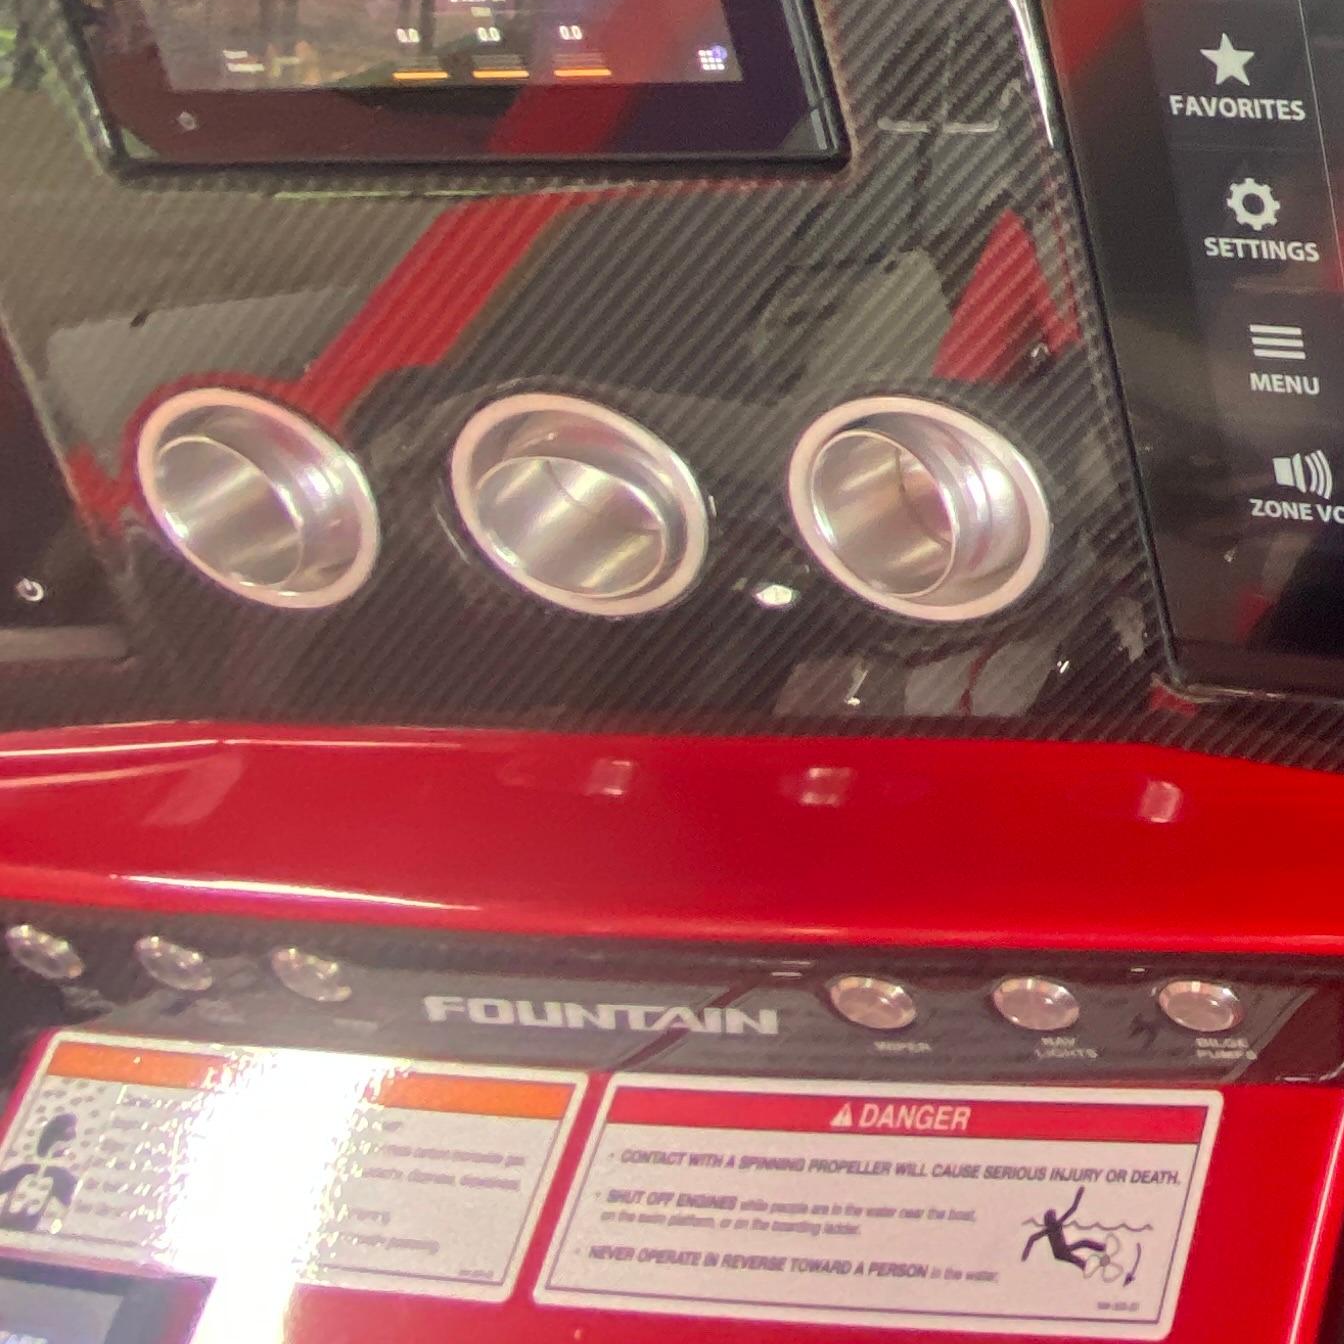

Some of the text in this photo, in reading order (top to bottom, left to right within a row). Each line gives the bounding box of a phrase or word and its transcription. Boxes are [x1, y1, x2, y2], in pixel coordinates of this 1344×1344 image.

[1169, 95, 1306, 121] FAVORITES
[1204, 237, 1320, 262] SETTINGS
[1250, 372, 1320, 395] MENU
[1250, 499, 1313, 521] ZONE
[422, 996, 778, 1035] FOUNTAIN
[859, 1104, 971, 1131] DANGER
[621, 1149, 1181, 1185] CONTACT WITH A SPINNING PROPELLER WILL CAUSE SERIOUS INJURY OR DEATH.
[646, 1191, 675, 1206] OFF
[588, 1245, 635, 1261] NEVER
[637, 1247, 702, 1266] OPERATE
[721, 1254, 788, 1272] REVERSE
[790, 1257, 853, 1275] TOWARD
[854, 1261, 865, 1275] A
[868, 1261, 928, 1278] PERSON
